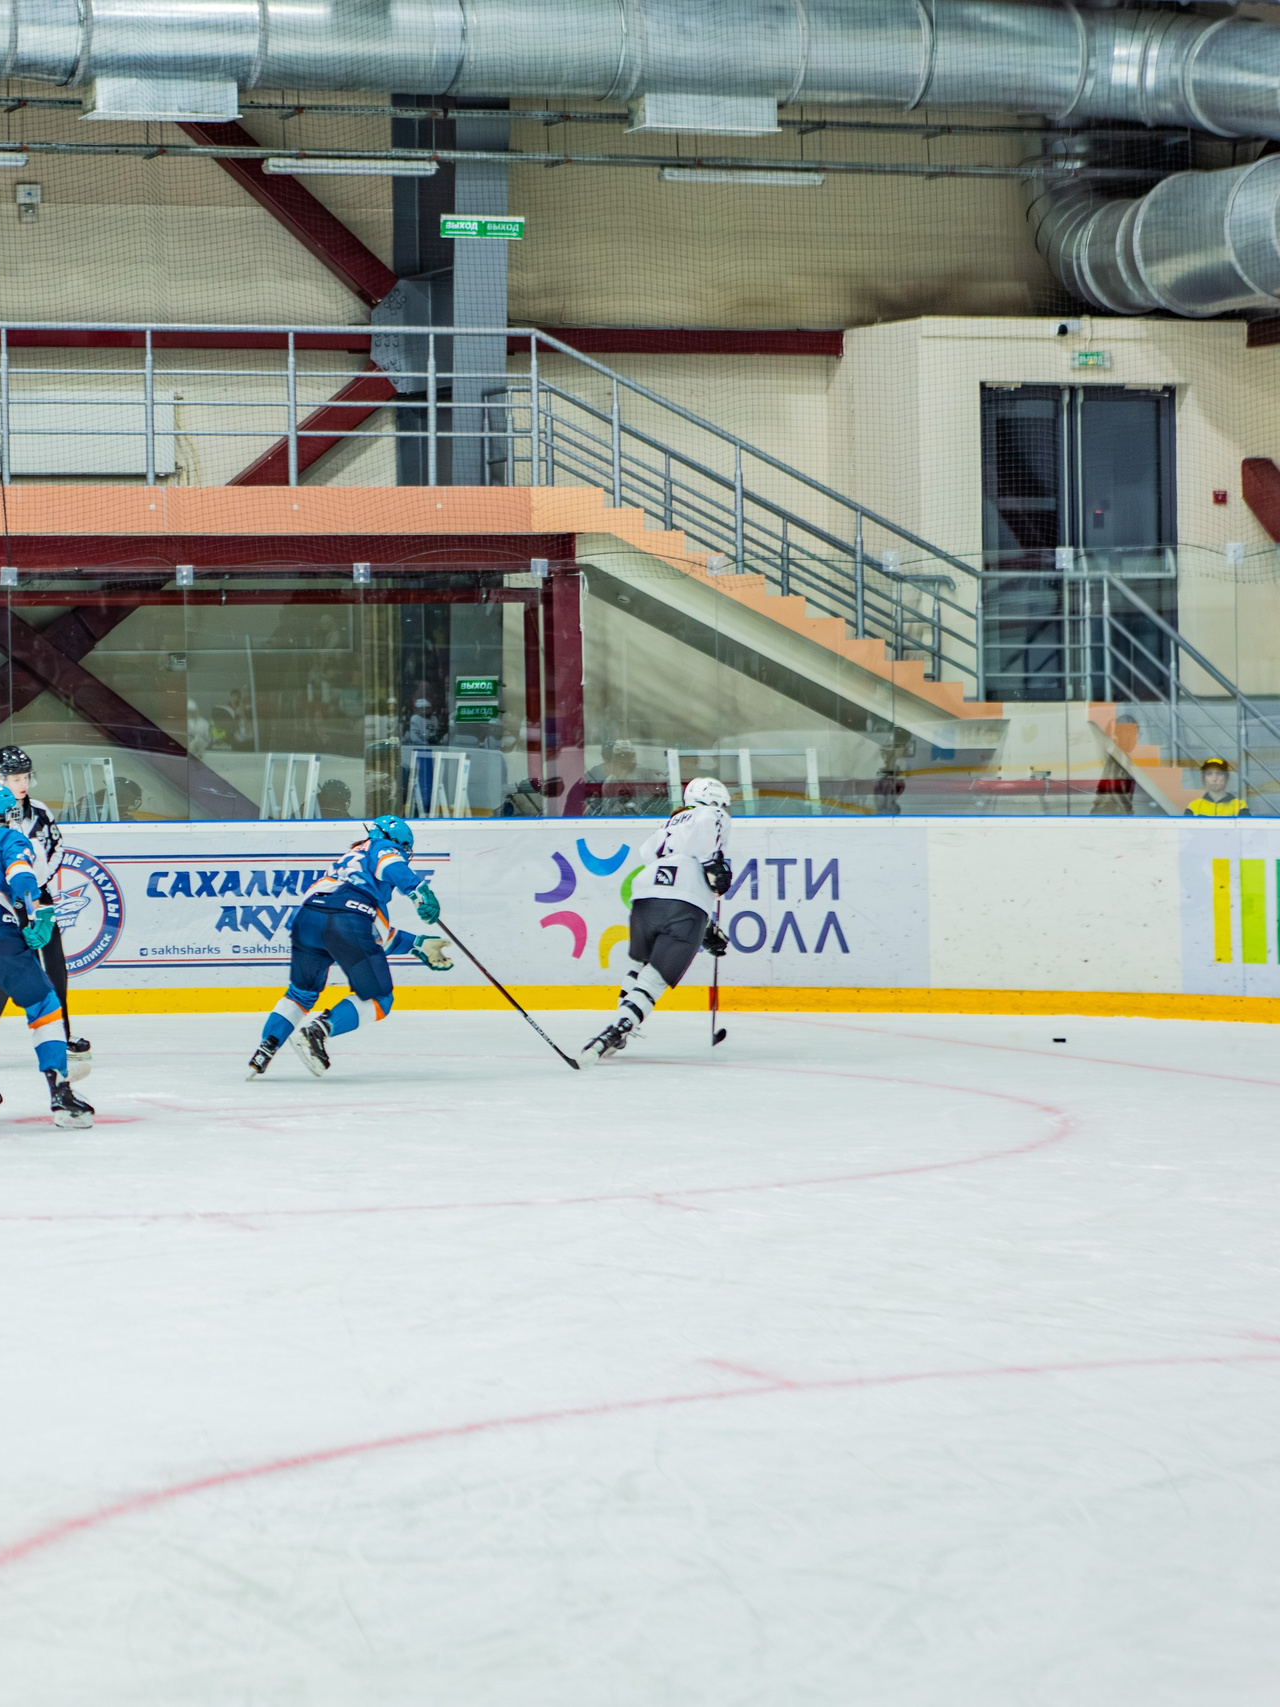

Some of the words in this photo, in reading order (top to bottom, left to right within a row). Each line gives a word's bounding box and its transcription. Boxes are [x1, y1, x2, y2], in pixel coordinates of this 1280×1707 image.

[445, 221, 478, 231] ВЫХОД
[486, 223, 520, 232] ВЫХОД
[460, 681, 494, 691] ВЫХОД
[460, 706, 494, 717] ВЫХОД
[85, 865, 120, 919] АКУЛЫ
[146, 869, 434, 899] САХАЛИН
[723, 858, 839, 900] ИТИ
[215, 905, 302, 941] АКУ
[728, 910, 850, 954] ОЛЛ
[66, 933, 112, 970] халинск
[151, 945, 220, 955] sakhsharks
[243, 943, 292, 954] sakhsha
